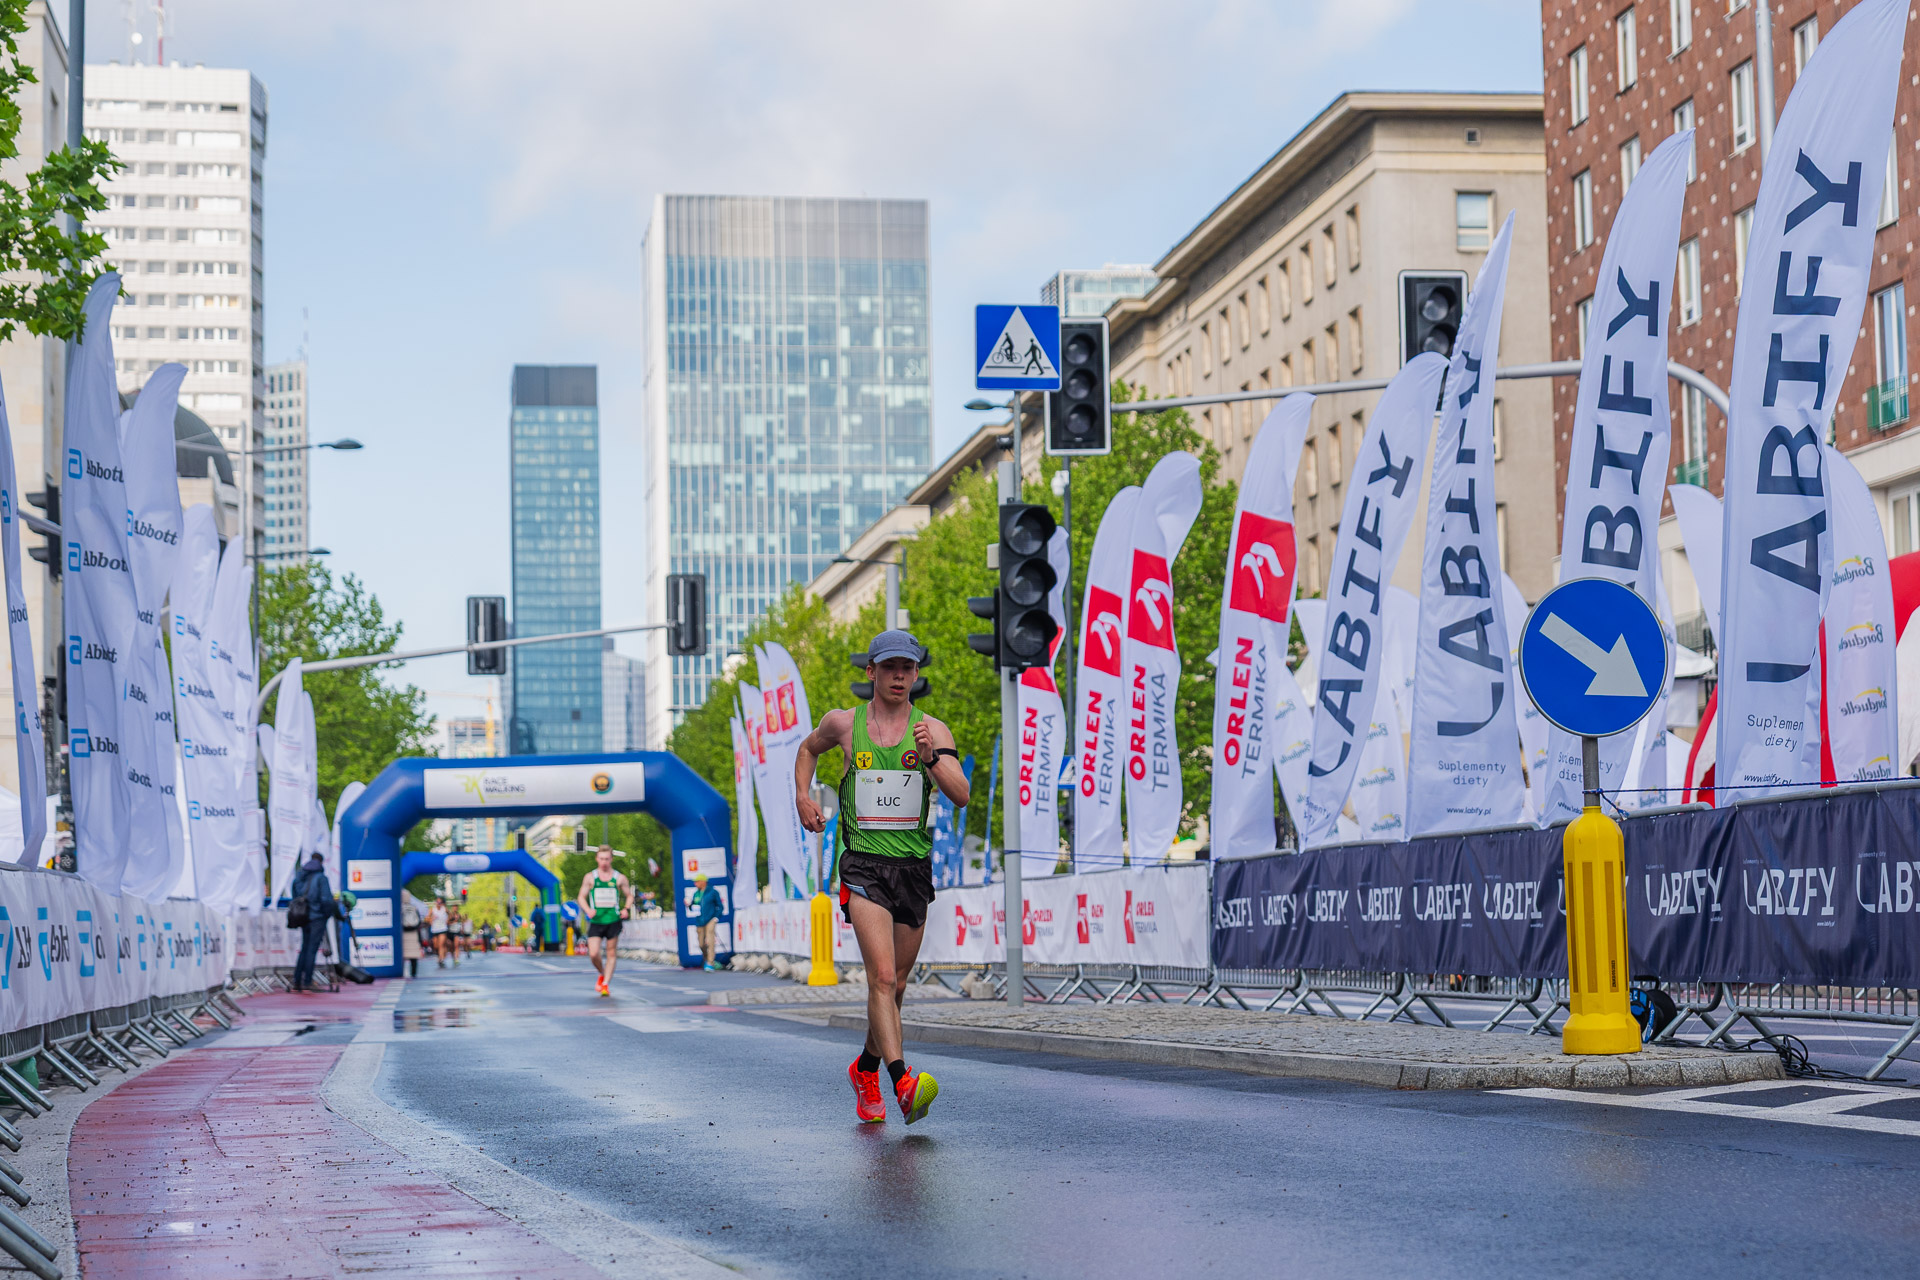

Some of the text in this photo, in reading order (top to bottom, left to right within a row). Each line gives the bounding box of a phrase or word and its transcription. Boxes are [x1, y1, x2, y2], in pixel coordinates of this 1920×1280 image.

[1581, 265, 1660, 580] BIFY
[133, 518, 178, 546] Abbott
[1308, 429, 1414, 778] LABIFY
[1129, 664, 1147, 781] ORLEN
[1151, 672, 1170, 793] TERMIKA
[1223, 637, 1254, 767] ORLEN
[1241, 644, 1267, 781] TERMIKA
[902, 774, 912, 787] 7
[1019, 706, 1039, 806] ORLEN
[1034, 713, 1057, 817] TERMIKA
[1081, 690, 1103, 798] ORLEN
[1099, 697, 1116, 808] TERMIKA
[1438, 760, 1507, 775] Suplementy
[1558, 768, 1584, 783] diet
[1765, 734, 1798, 753] diety
[877, 796, 901, 807] ŁUC
[1453, 775, 1489, 788] diety
[1413, 882, 1473, 920] LABIFY
[1645, 866, 1723, 916] LABIFY
[1743, 866, 1837, 916] LABIFY
